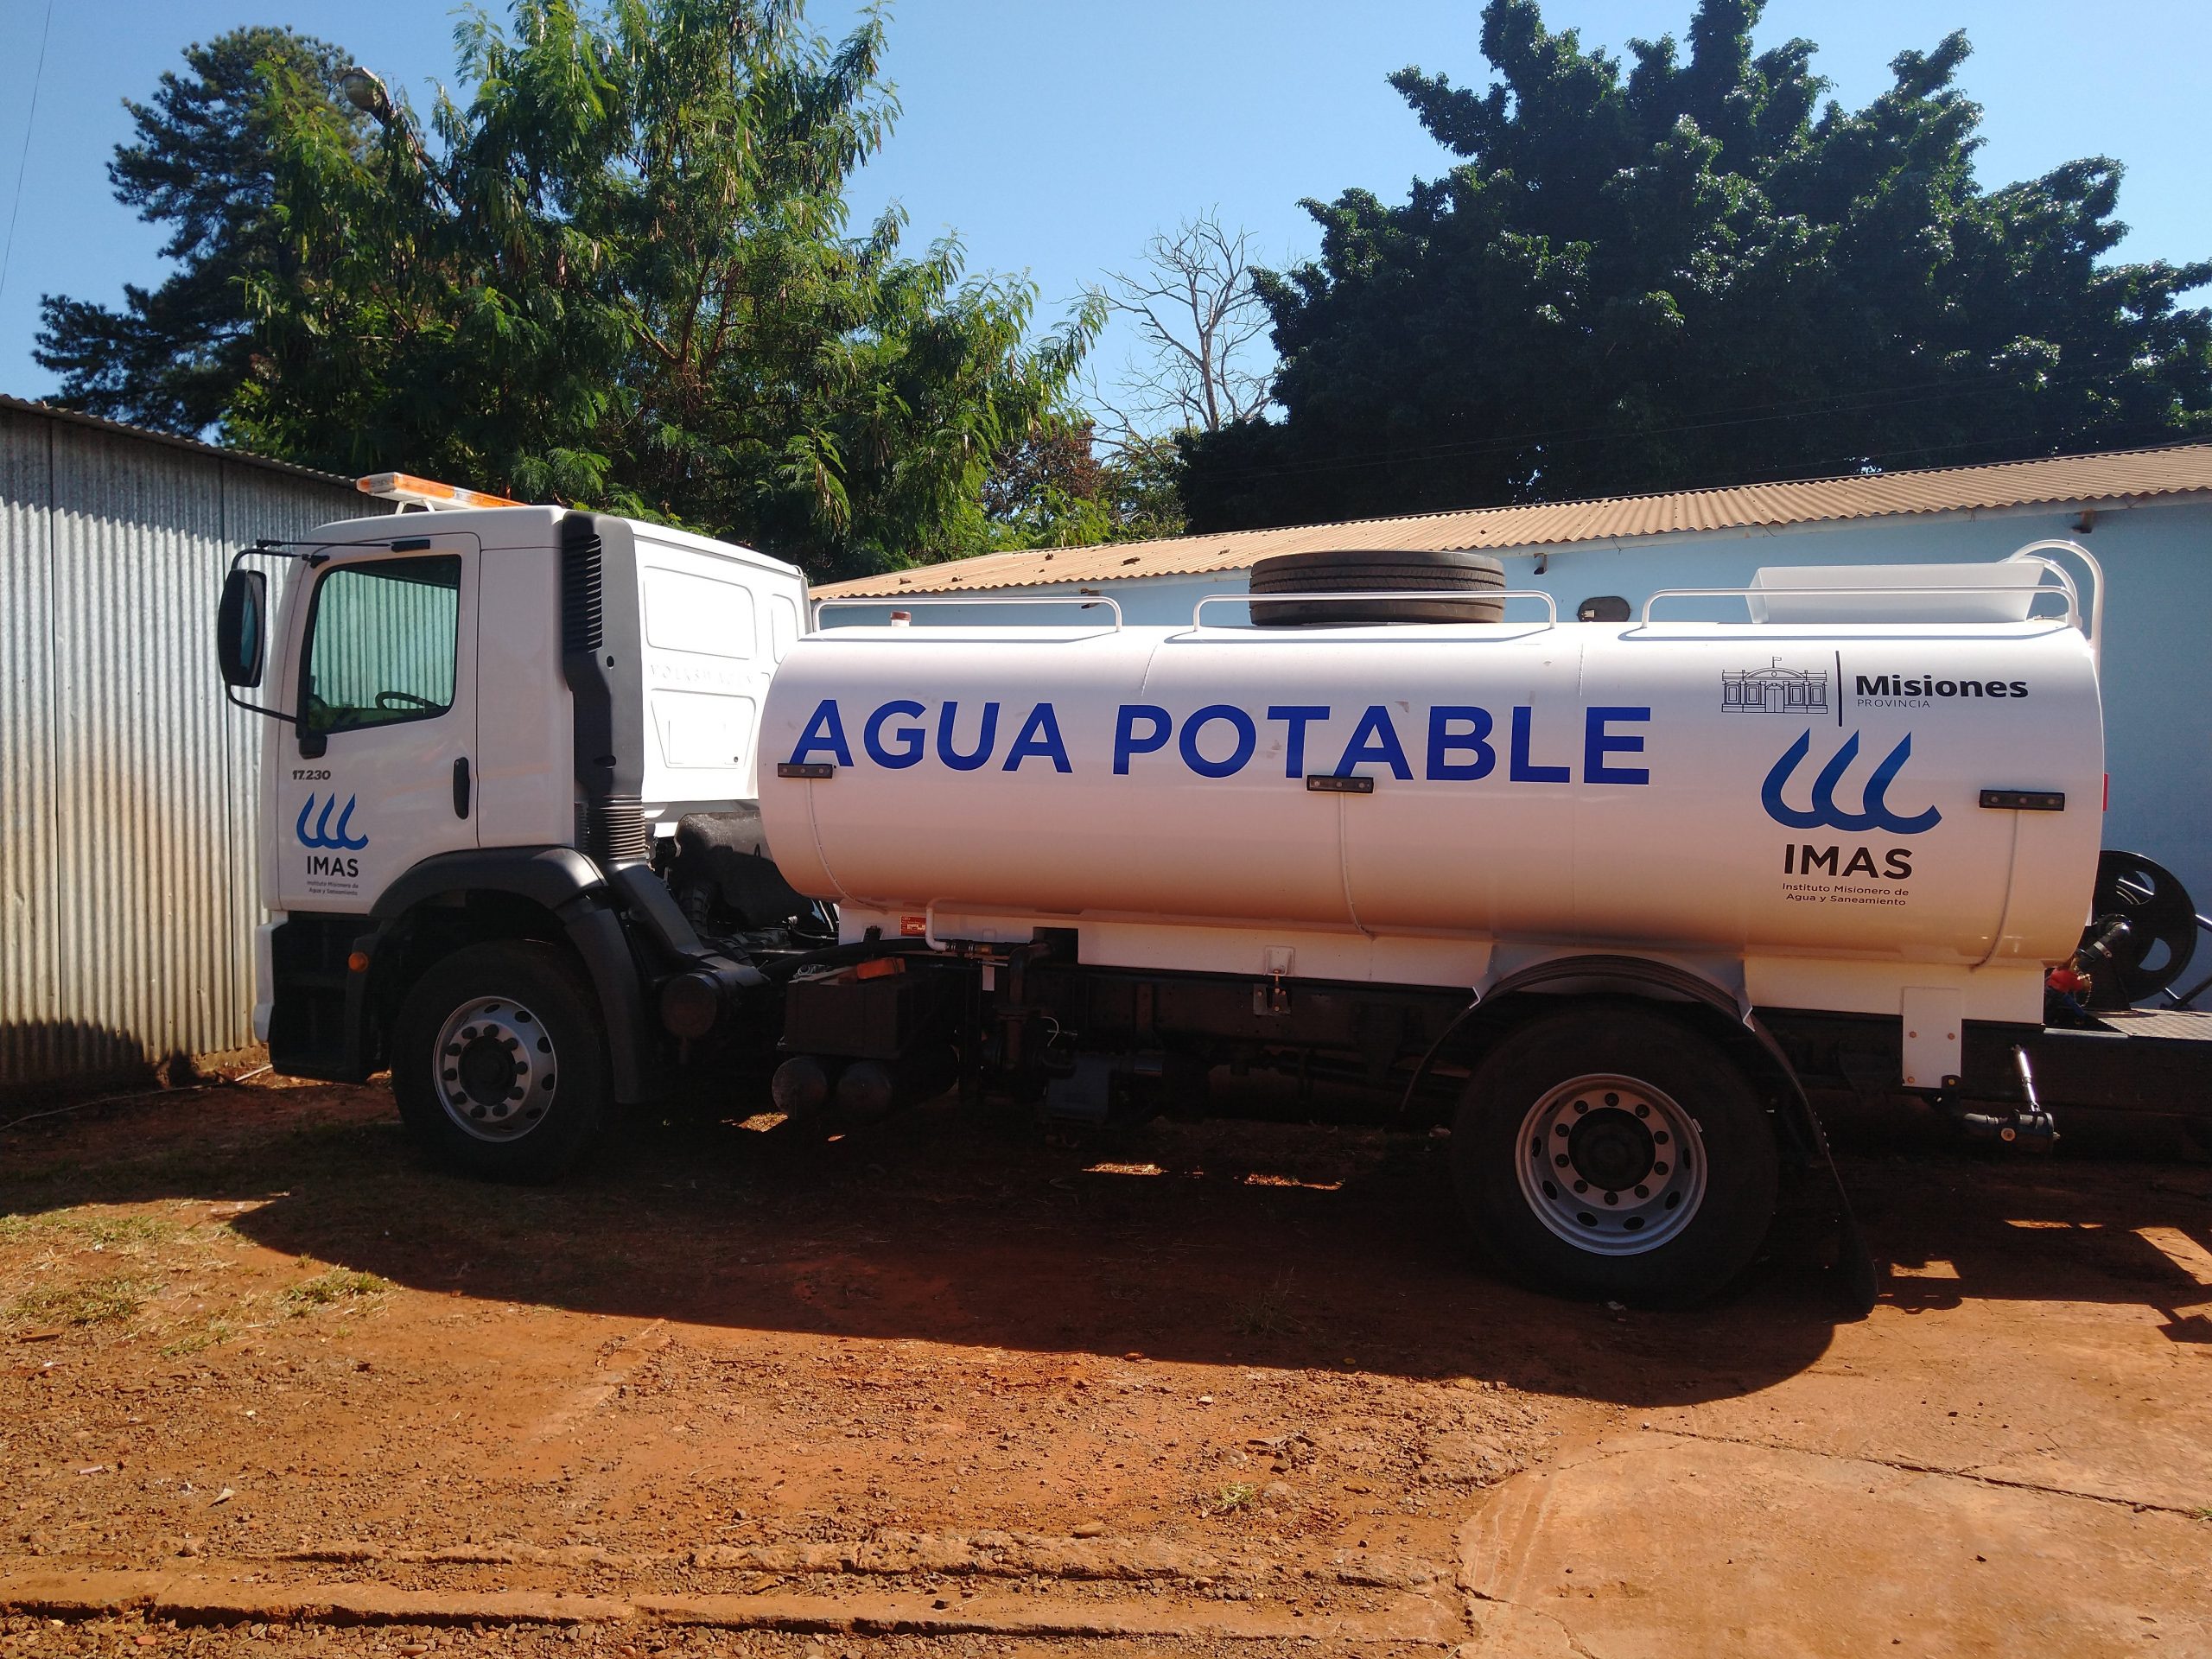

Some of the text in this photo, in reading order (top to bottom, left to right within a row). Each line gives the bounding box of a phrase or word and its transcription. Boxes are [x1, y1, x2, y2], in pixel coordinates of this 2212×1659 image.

[650, 664, 753, 684] VOLKSWAGN
[1856, 674, 2029, 698] Misiones
[1857, 698, 1930, 708] PROVINCIA
[789, 699, 1651, 785] AGUA POTABLE
[292, 770, 332, 780] 17.230
[307, 855, 359, 877] IMAS
[1784, 843, 1913, 880] IMAS
[1783, 882, 1830, 893] Instituto
[1834, 885, 1891, 895] Misionero
[1786, 893, 1816, 902] Agua
[1830, 895, 1906, 906] Saneamiento
